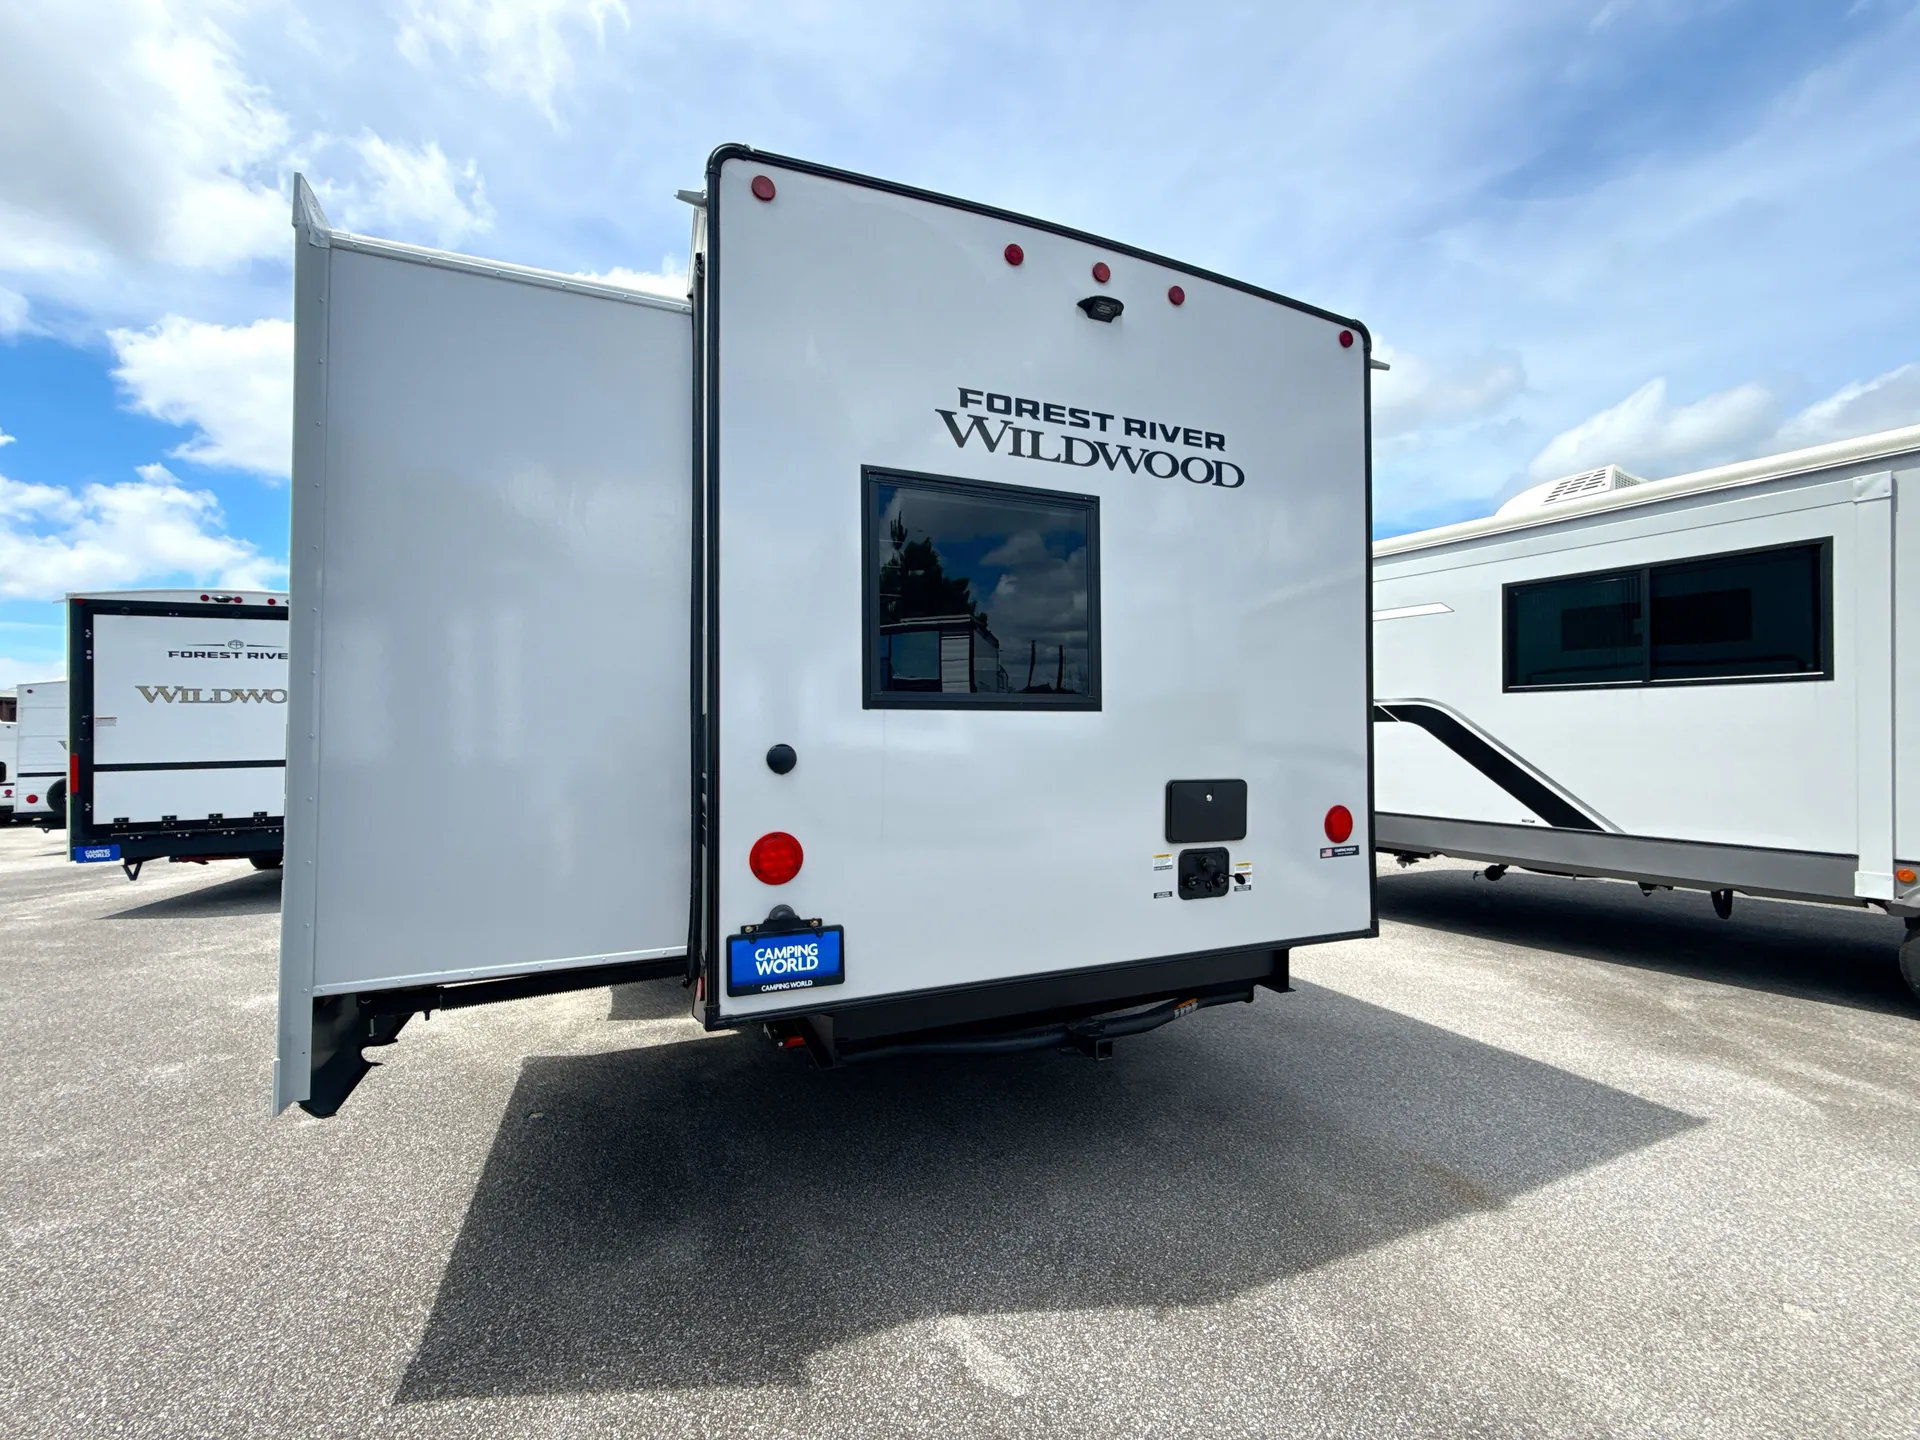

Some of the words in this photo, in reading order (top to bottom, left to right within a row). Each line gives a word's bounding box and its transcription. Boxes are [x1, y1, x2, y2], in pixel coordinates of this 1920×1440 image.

[957, 387, 1115, 432] FOREST
[1122, 416, 1226, 452] RIVER
[935, 408, 1245, 489] WILDWOOD
[168, 651, 242, 659] FOREST
[247, 652, 288, 660] RIVE
[135, 685, 288, 704] WILDWO
[755, 943, 818, 961] CAMPING
[755, 956, 818, 975] WORLD
[761, 983, 790, 992] CAMPING
[790, 980, 813, 988] WORLD
